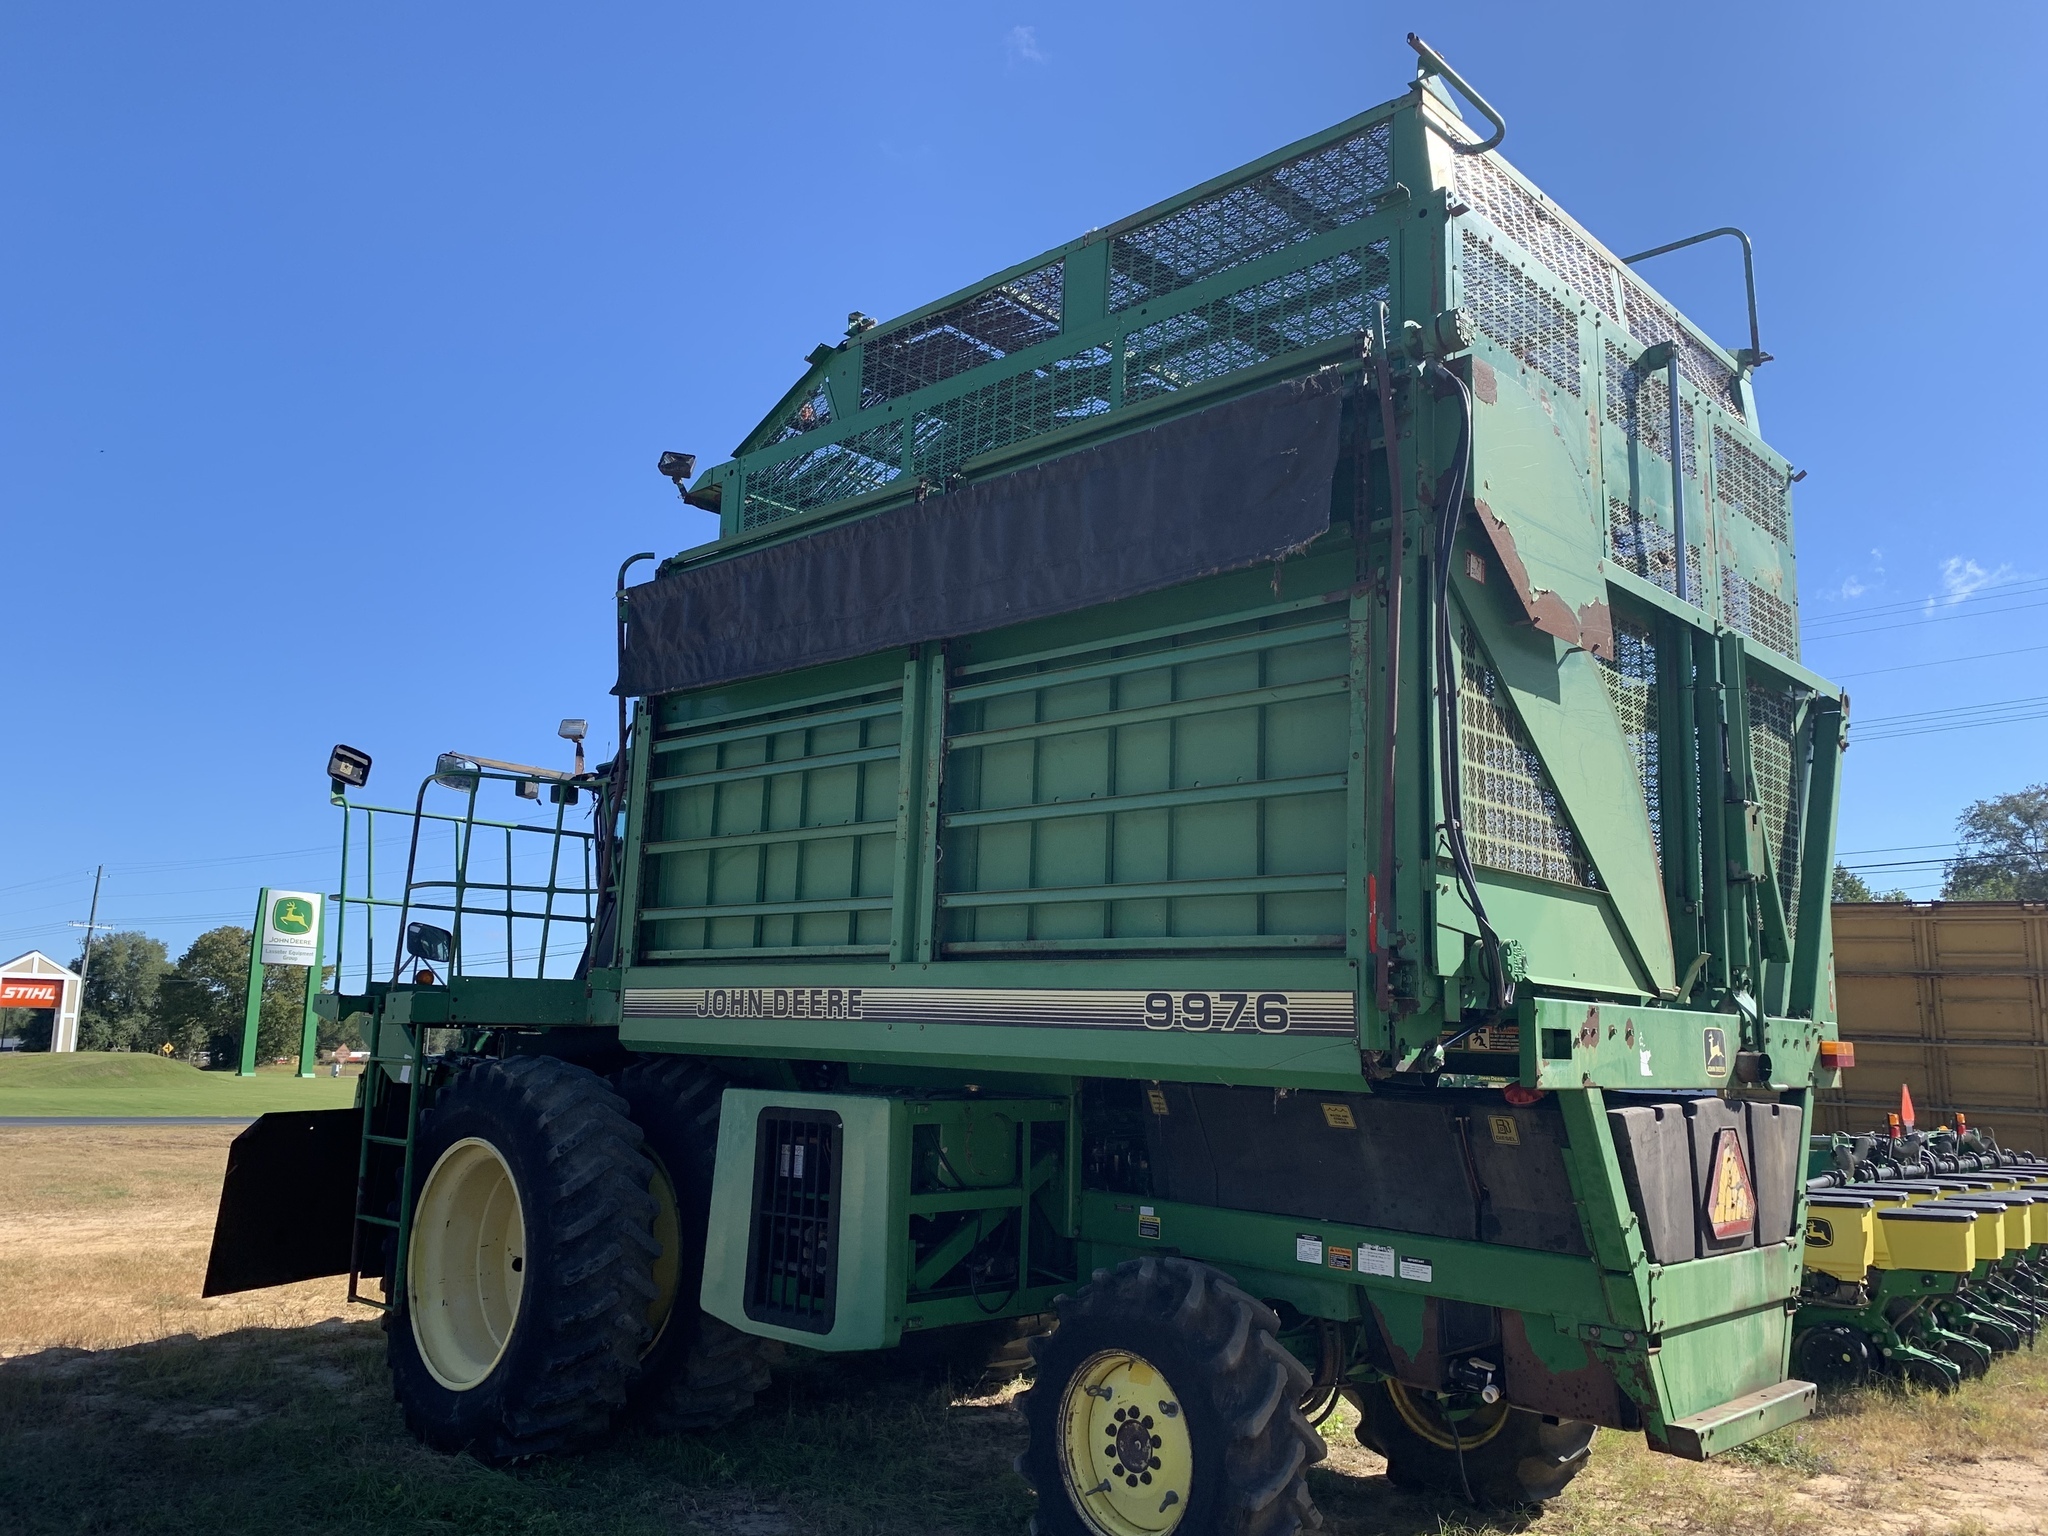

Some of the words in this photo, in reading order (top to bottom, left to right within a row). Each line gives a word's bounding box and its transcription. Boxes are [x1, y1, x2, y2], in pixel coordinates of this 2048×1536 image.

[1, 986, 56, 1000] STIHL
[697, 989, 763, 1018] JOHN
[772, 989, 863, 1020] DEERE
[1144, 992, 1290, 1033] 9976
